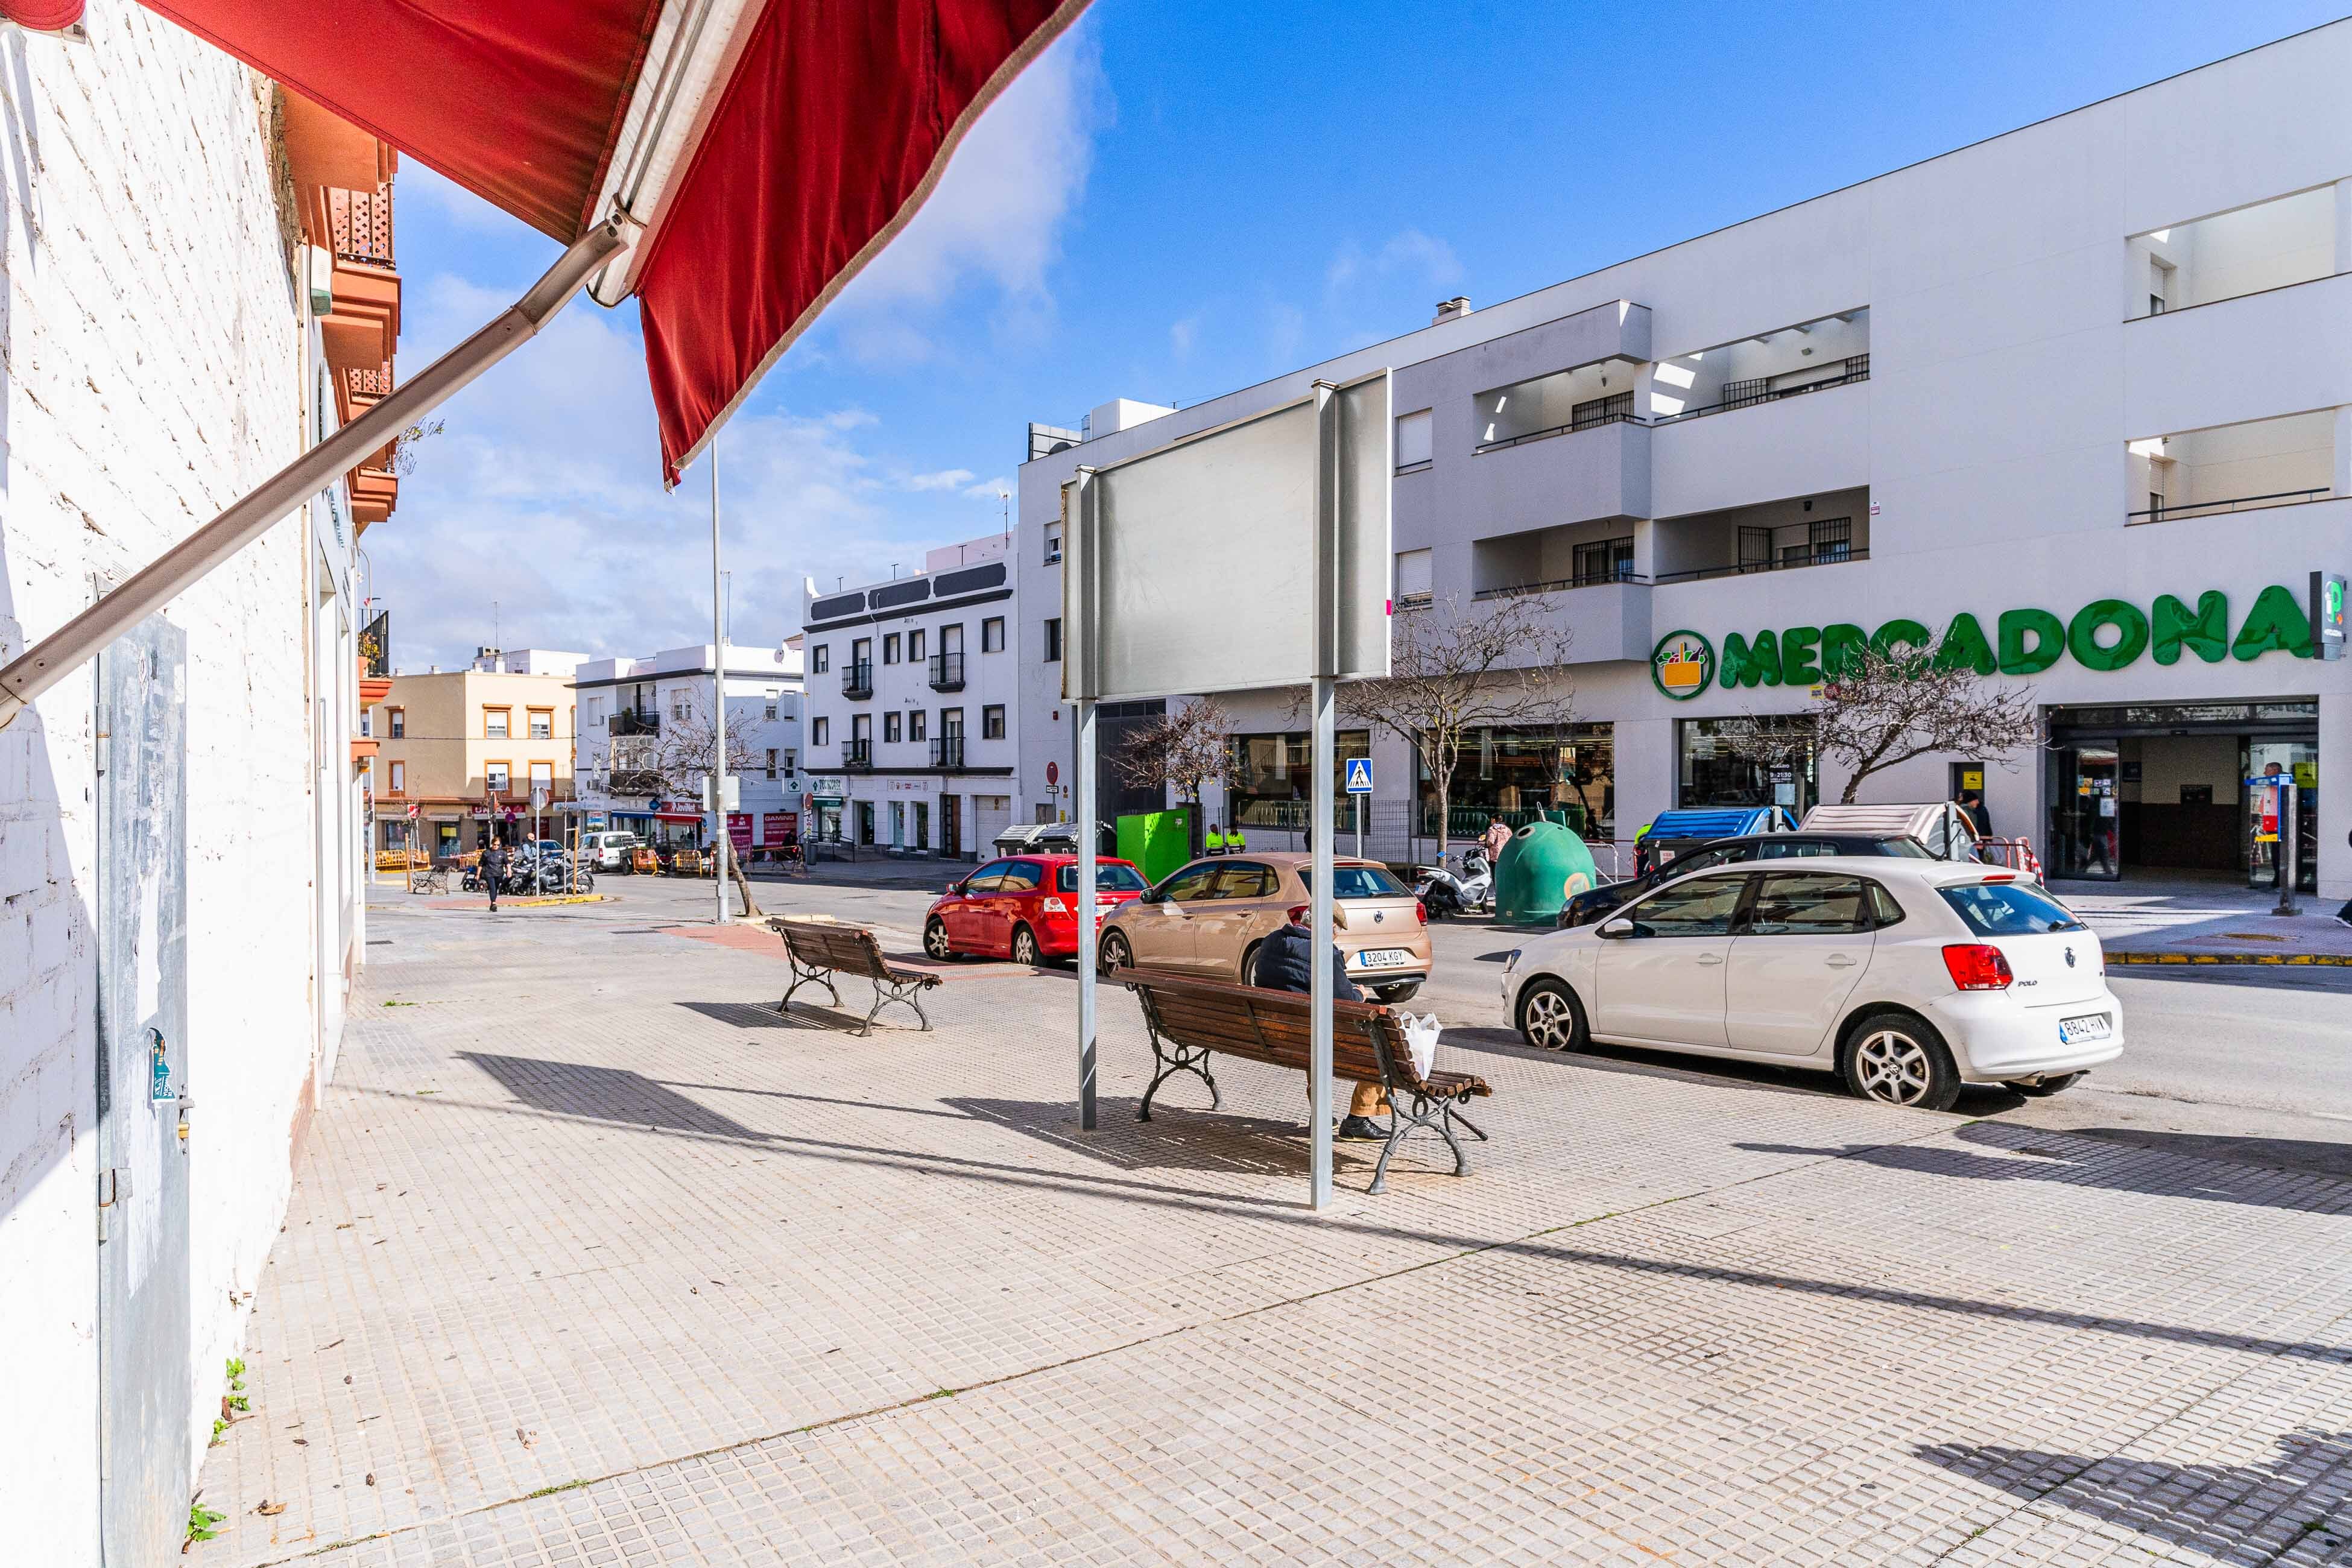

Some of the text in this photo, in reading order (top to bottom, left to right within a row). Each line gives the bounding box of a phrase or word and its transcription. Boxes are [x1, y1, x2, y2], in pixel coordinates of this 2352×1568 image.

[1719, 584, 2315, 689] MERCADONA
[1367, 952, 1403, 963] 3204 KGY
[2064, 1019, 2090, 1035] 8842
